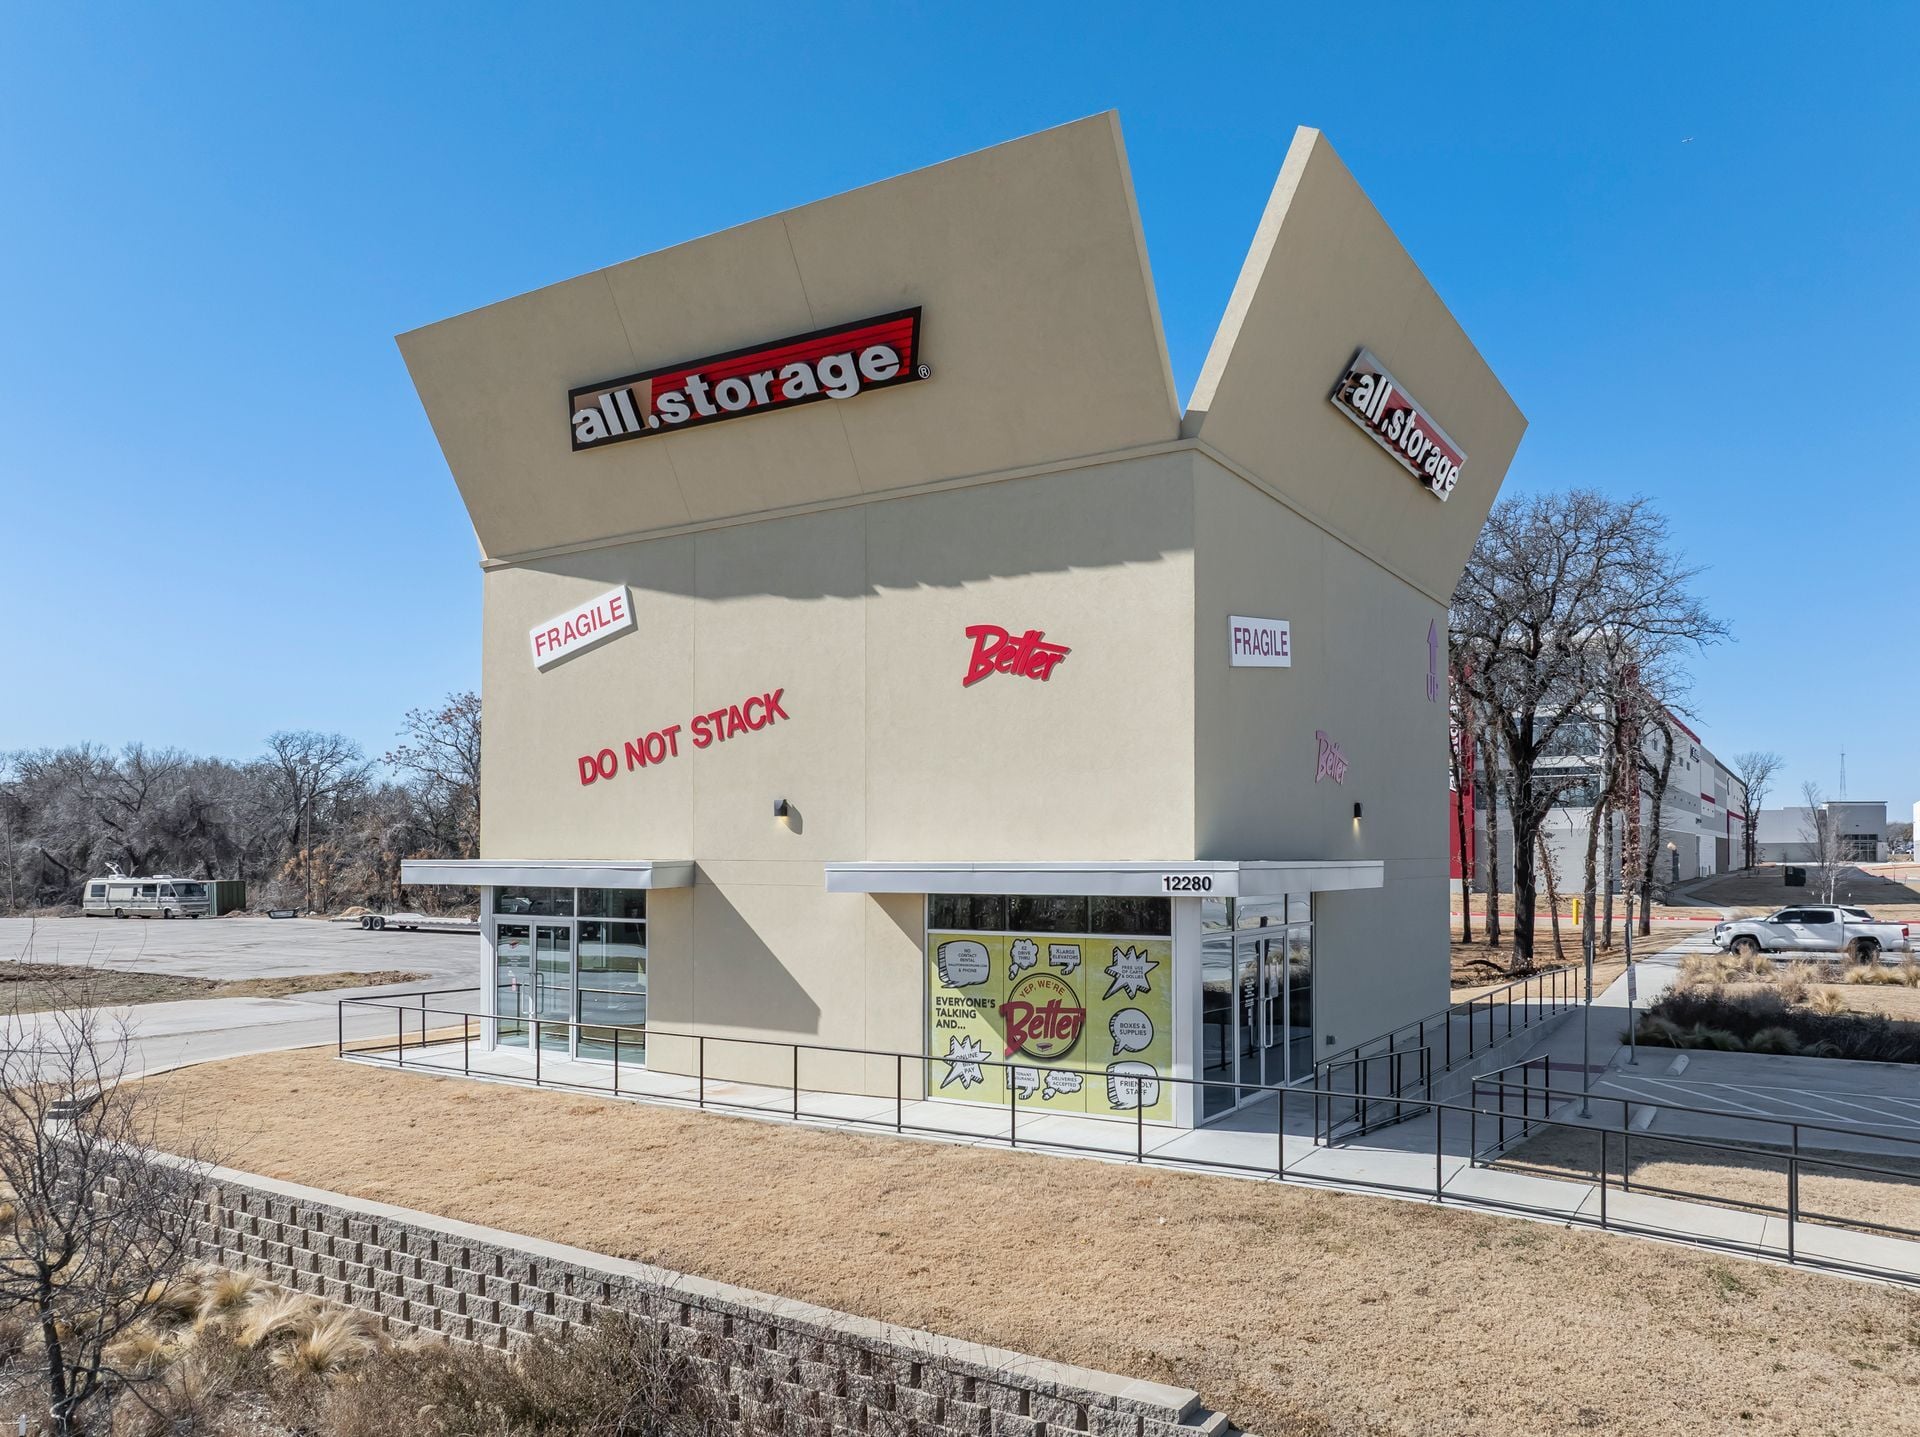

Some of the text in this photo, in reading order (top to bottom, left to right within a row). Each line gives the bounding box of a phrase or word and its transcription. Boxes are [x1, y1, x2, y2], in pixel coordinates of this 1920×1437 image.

[534, 596, 626, 657] FRAGILE
[1233, 627, 1288, 657] FRAGILE
[963, 624, 1072, 688] Better
[578, 688, 790, 786] DO NOT STACK
[1163, 876, 1212, 891] 12280
[1037, 980, 1066, 996] WE'RE
[935, 996, 996, 1008] EVERYONE'S
[935, 1008, 977, 1019] TALKING
[935, 1018, 966, 1030] AND...
[999, 998, 1087, 1058] Better
